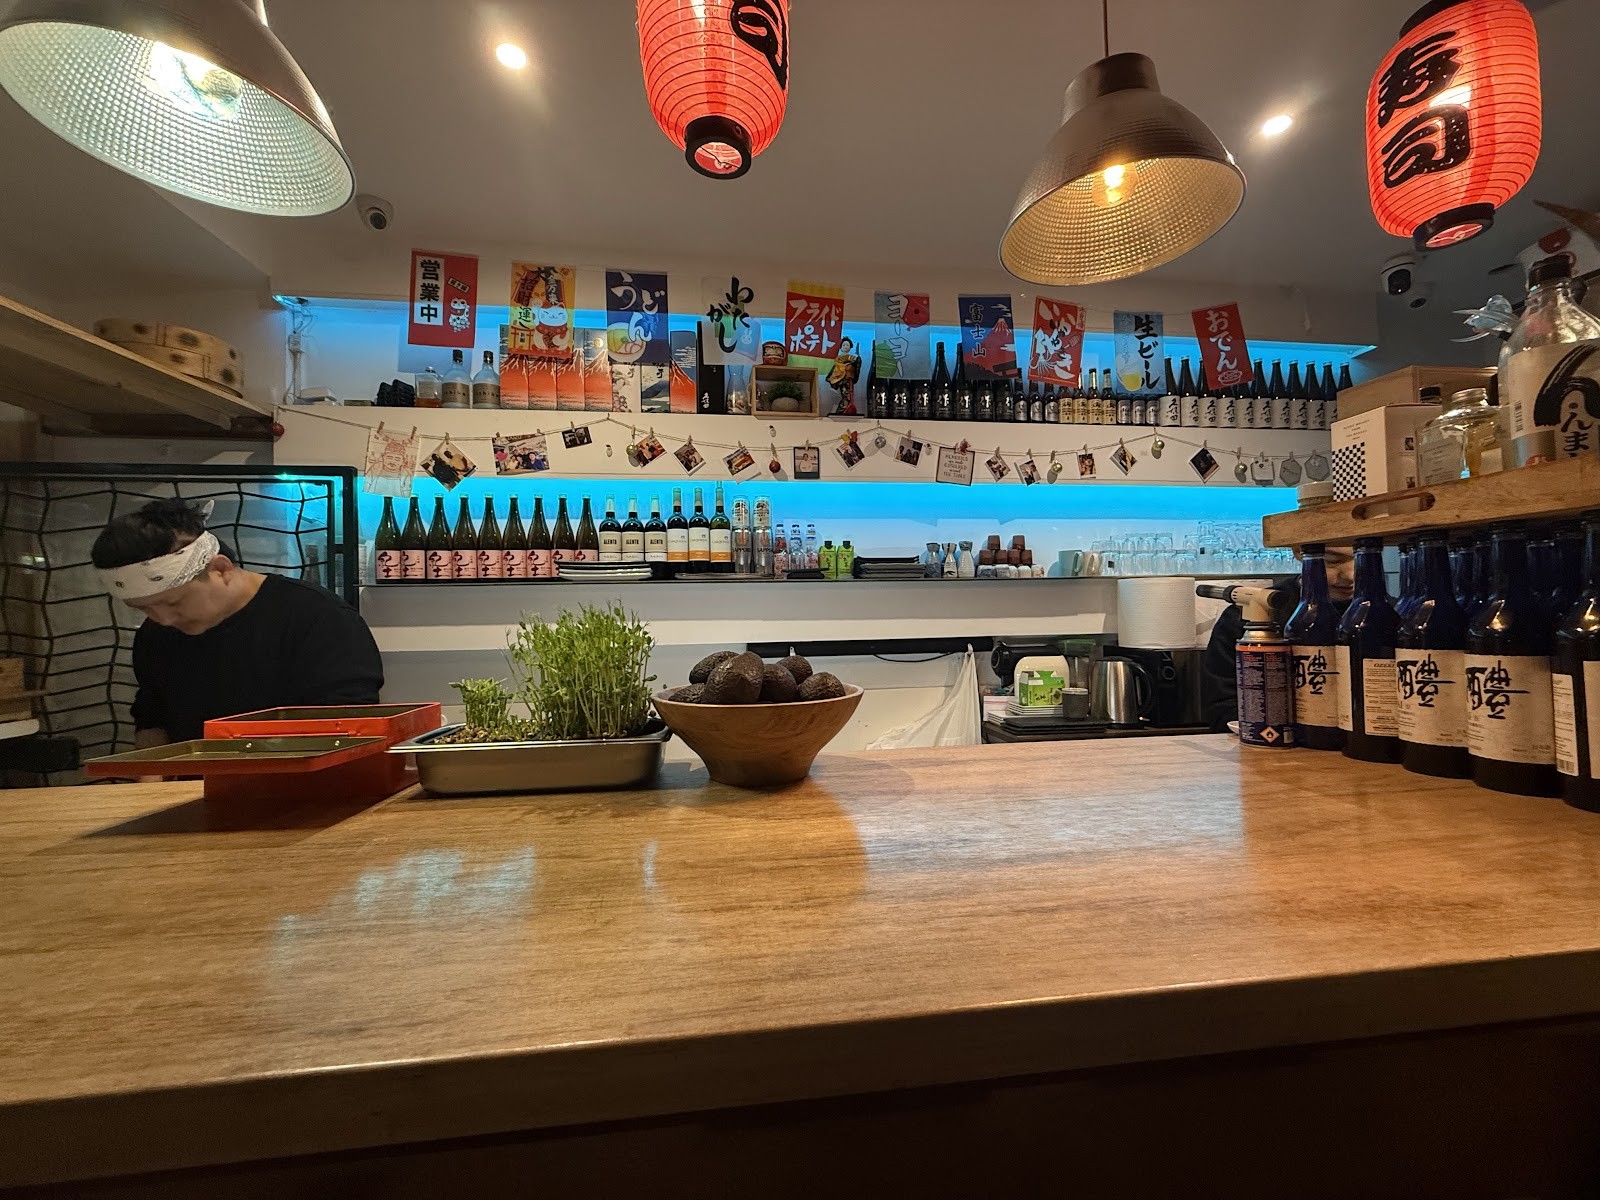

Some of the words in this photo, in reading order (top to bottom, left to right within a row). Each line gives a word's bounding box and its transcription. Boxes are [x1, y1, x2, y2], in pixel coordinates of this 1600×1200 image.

[420, 259, 440, 323] 営業中
[610, 270, 666, 342] うどん
[788, 299, 841, 327] フライド
[790, 325, 836, 354] ポテト
[969, 303, 986, 358] 富士山
[1134, 314, 1161, 389] 生ビール
[1206, 310, 1238, 372] おでん
